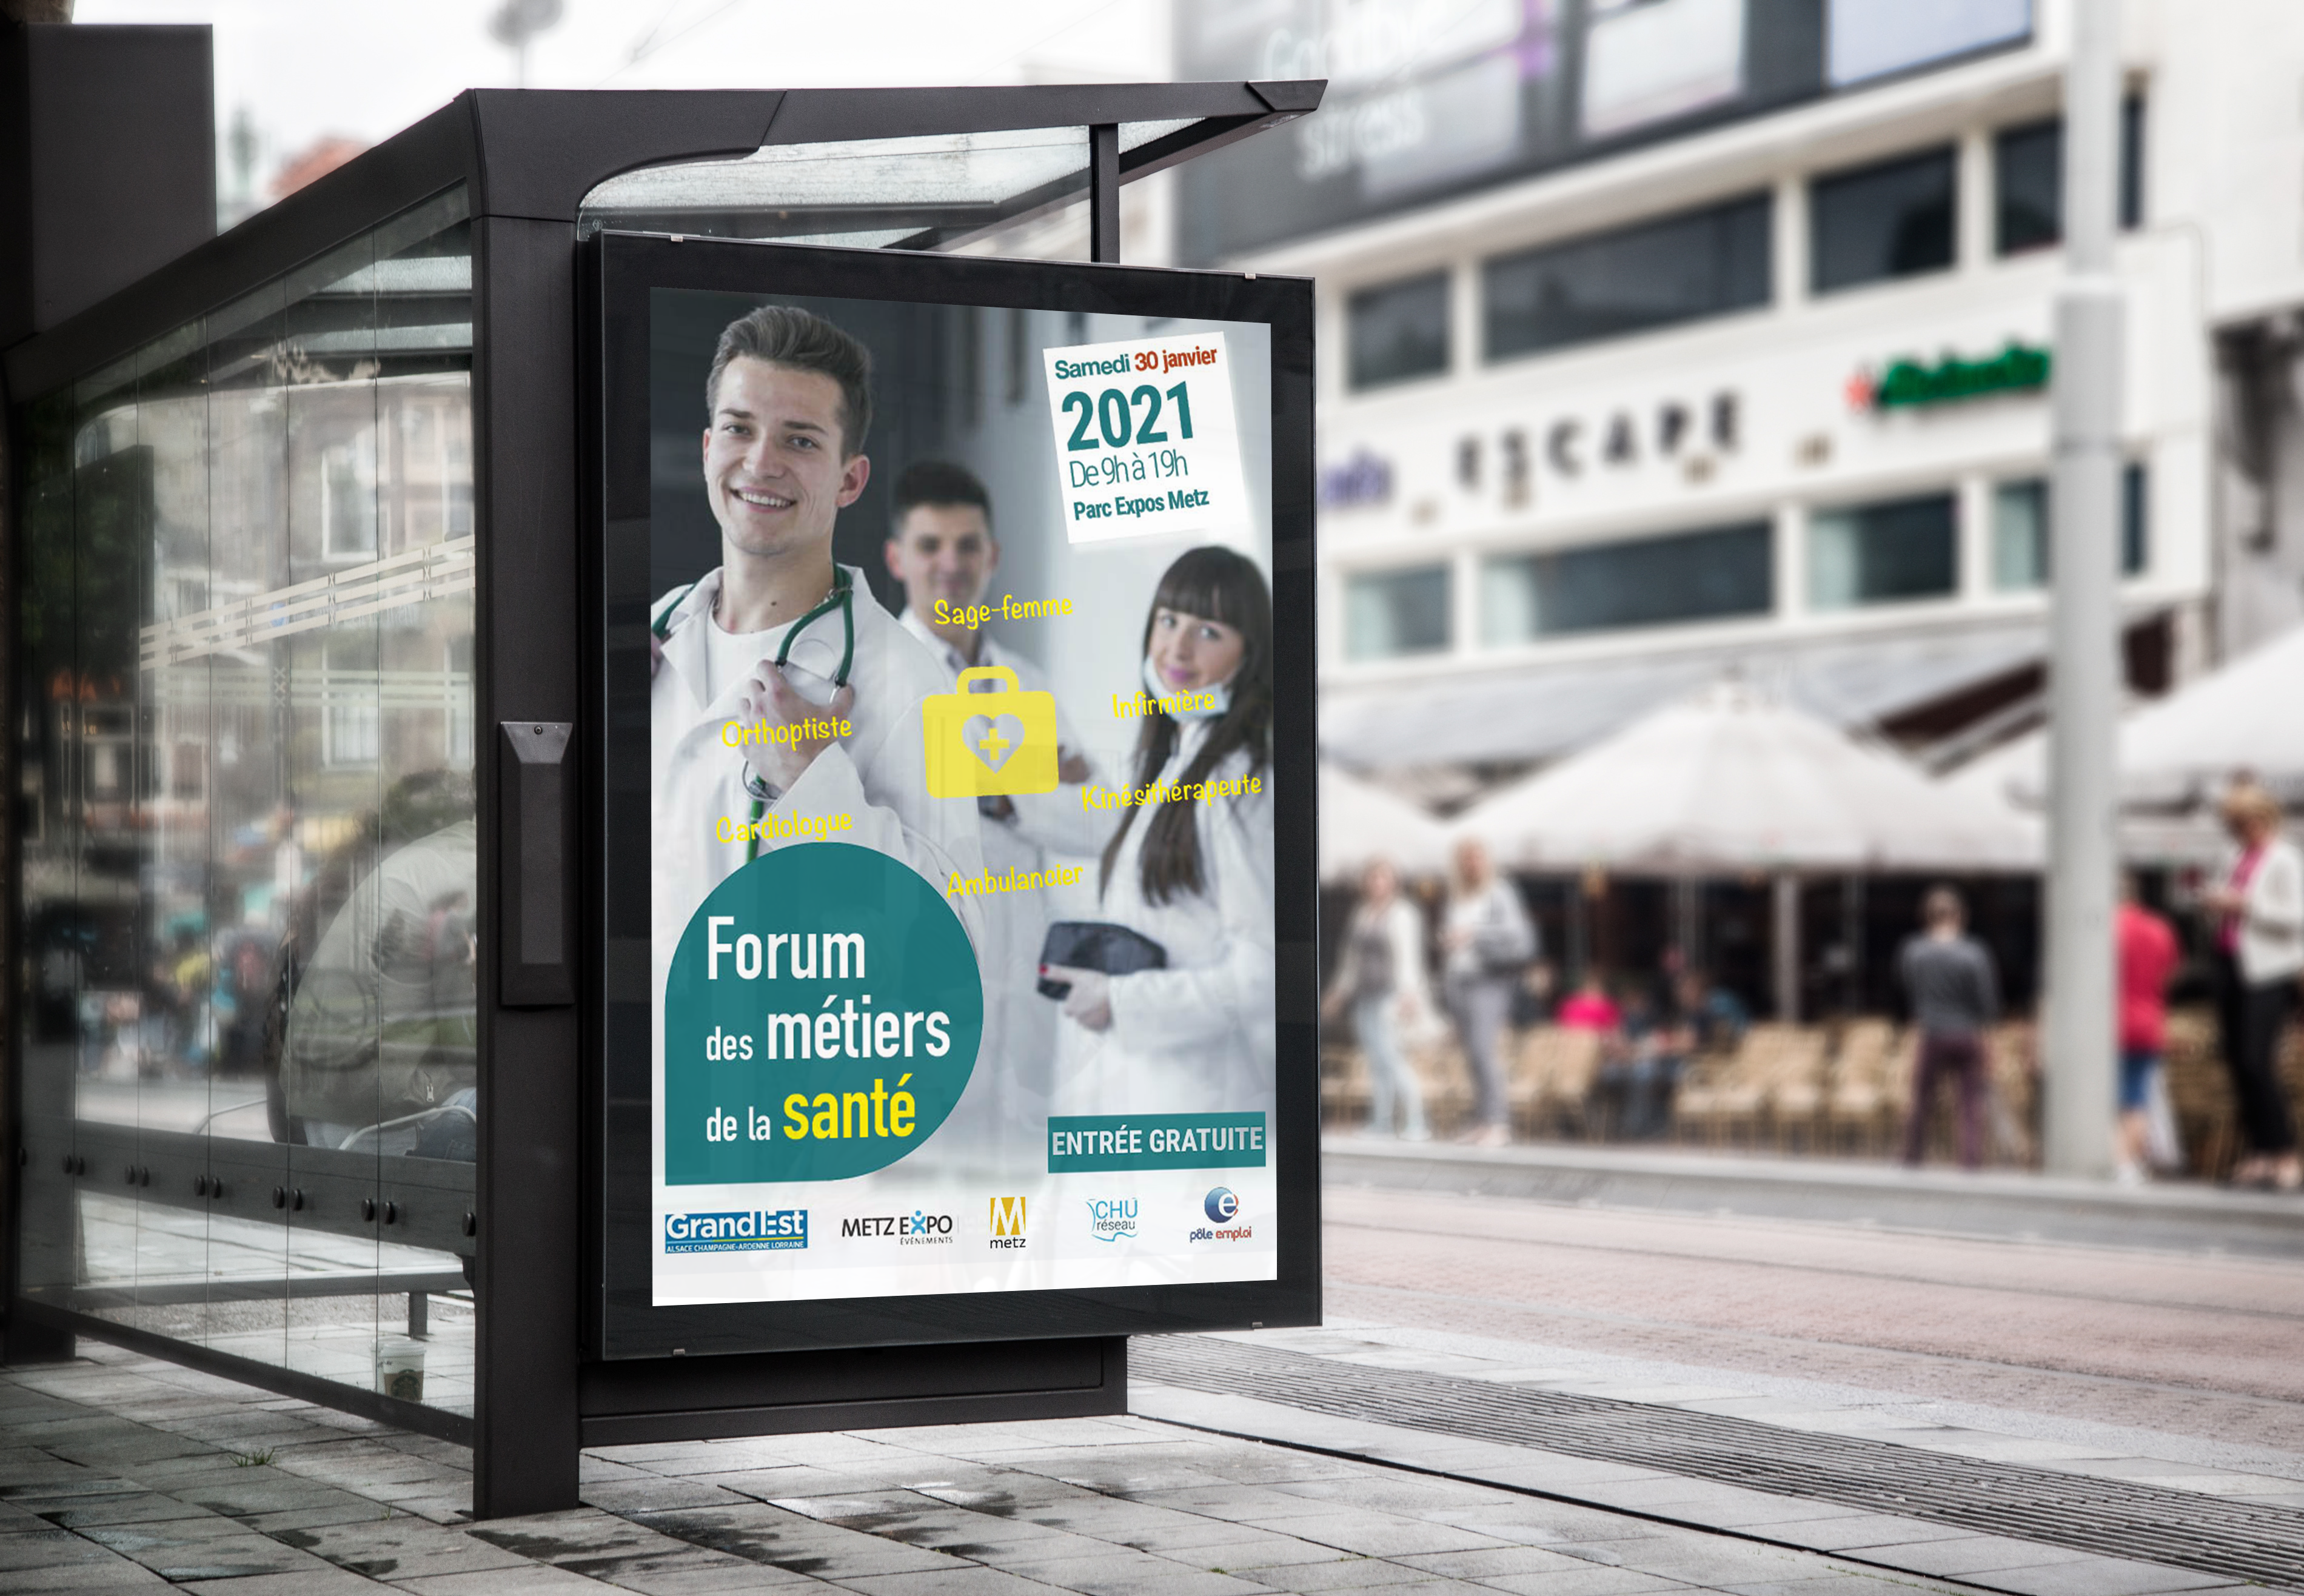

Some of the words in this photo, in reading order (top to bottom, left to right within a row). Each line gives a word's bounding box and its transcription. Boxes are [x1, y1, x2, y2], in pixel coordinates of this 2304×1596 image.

[1055, 354, 1131, 379] Samedi
[1134, 351, 1159, 372] 30
[1162, 346, 1217, 374] janvier
[1062, 381, 1193, 451] 2021
[1070, 460, 1099, 488] De
[1101, 455, 1129, 484] 9h
[1133, 452, 1145, 480] à
[1148, 449, 1188, 478] 19h
[1073, 501, 1112, 520] Parc
[1115, 495, 1165, 517] Expos
[1168, 489, 1210, 510] Metz
[934, 594, 1073, 630] Sage-femme
[1112, 689, 1215, 719] Infirmière
[722, 716, 852, 751] Orthoptiste
[1082, 774, 1262, 813] Kinésithérapeute
[716, 810, 852, 843] Cardiologue
[947, 864, 1084, 898] Ambulancier
[708, 916, 865, 980] Forum
[706, 1026, 753, 1061] des
[768, 994, 950, 1060] métiers
[706, 1107, 737, 1142] de
[749, 1106, 771, 1141] la
[783, 1073, 916, 1140] santé
[1052, 1125, 1142, 1156] ENTRÉE
[1150, 1126, 1264, 1153] GRATUITE
[666, 1212, 755, 1239] Grand
[760, 1210, 804, 1236] Est
[842, 1217, 895, 1237] METZ
[899, 1210, 953, 1235] EXPO
[1096, 1200, 1137, 1219] CHU
[1097, 1219, 1135, 1231] réseau
[900, 1236, 953, 1246] ÉVÉNEMENTS
[990, 1236, 1026, 1249] metz
[1190, 1227, 1213, 1243] pôle
[1216, 1226, 1251, 1242] emploi
